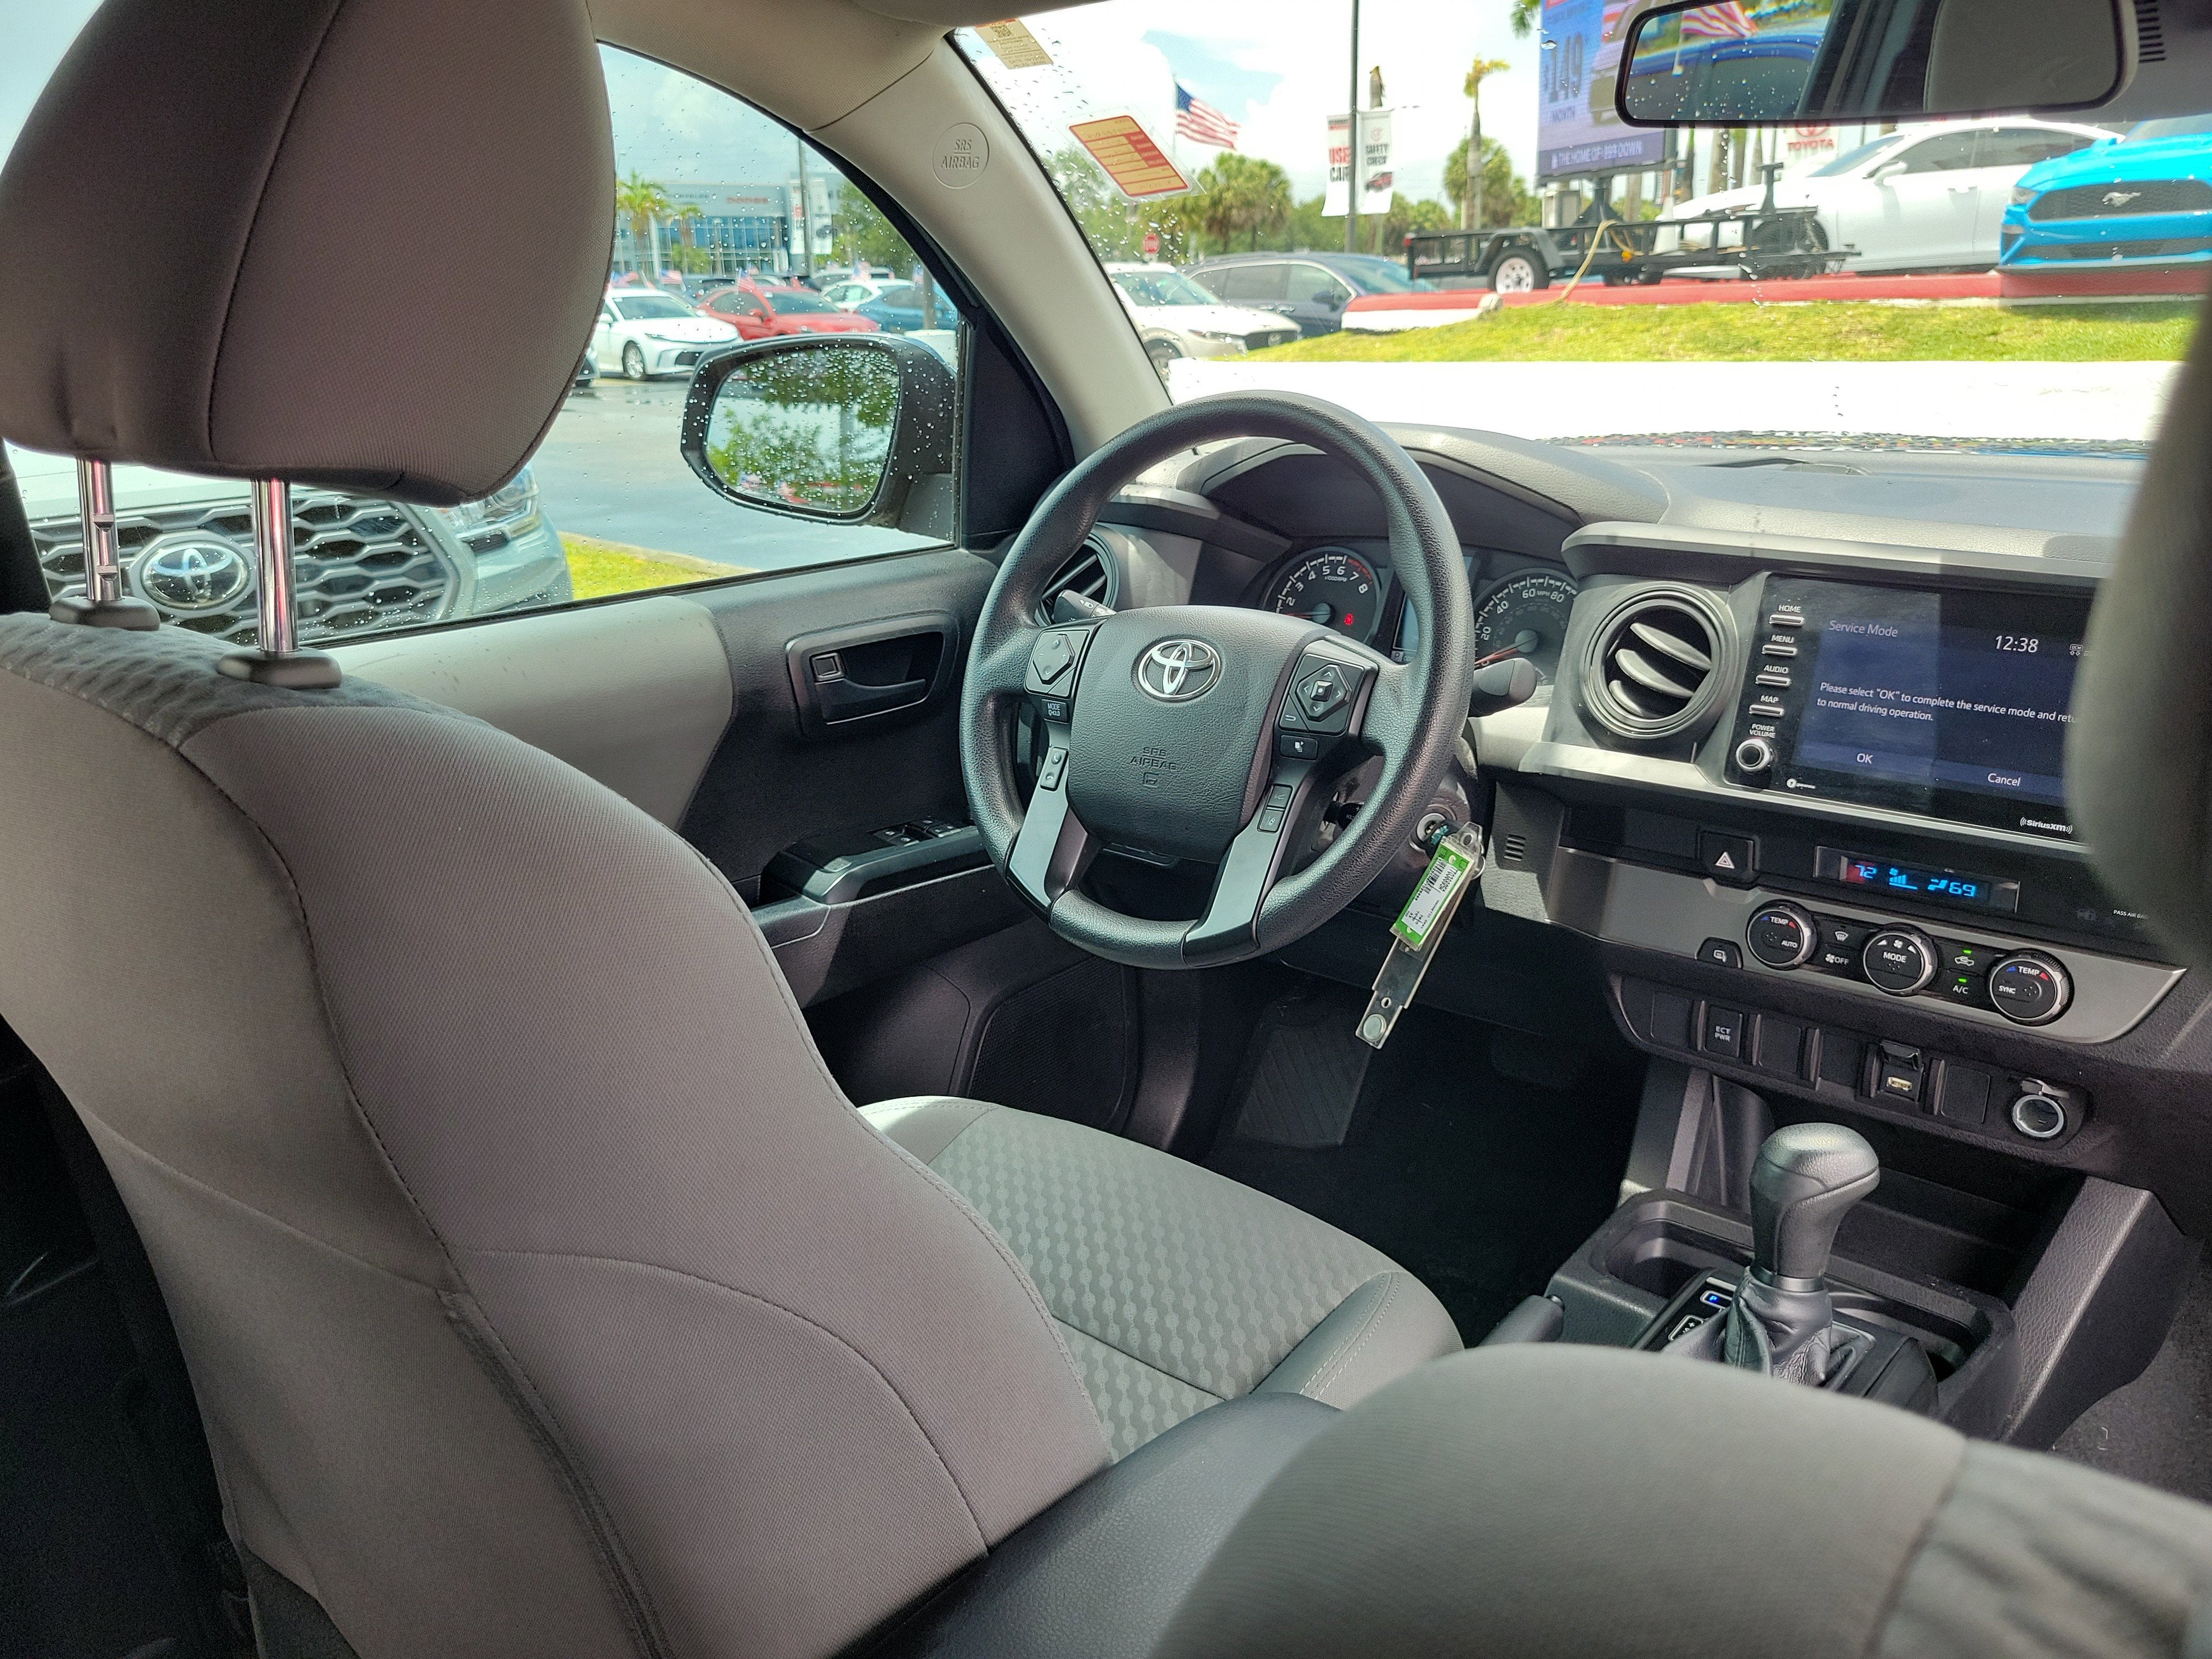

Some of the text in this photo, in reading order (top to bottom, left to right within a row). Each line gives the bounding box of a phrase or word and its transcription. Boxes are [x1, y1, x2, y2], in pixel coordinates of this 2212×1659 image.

[955, 139, 972, 151] SRS
[1787, 138, 1833, 151] TOYOTA
[1329, 146, 1351, 164] USE
[941, 156, 979, 169] AIRBAG
[1308, 571, 1317, 580] 4
[1322, 566, 1330, 575] 5
[1336, 566, 1346, 575] 6
[1350, 572, 1359, 581] 7
[1295, 582, 1304, 591] 3
[1358, 583, 1368, 594] 8
[1522, 588, 1536, 599] 60
[1550, 591, 1564, 603] 80
[1286, 597, 1295, 606] 2
[1497, 601, 1509, 614] 40
[1778, 605, 1802, 613] HOME
[1829, 620, 1898, 637] Service Mode
[1481, 627, 1491, 641] 20
[1771, 635, 1794, 644] MENU
[1995, 635, 2039, 653] 12:38
[1763, 665, 1789, 674] AUDIO
[1760, 695, 1779, 703] MAP
[1820, 682, 1847, 695] Please
[1849, 687, 1874, 697] select
[1876, 689, 1900, 700] "OK"
[1901, 693, 1911, 702] to
[1912, 695, 1954, 708] complete
[1956, 700, 1972, 710] the
[1973, 703, 2006, 714] service
[2008, 708, 2035, 718] mode
[2037, 712, 2056, 721] and
[1047, 702, 1060, 710] MODE
[1817, 698, 1933, 721] to normal driving operation.
[1751, 724, 1775, 732] POWER
[1749, 729, 1776, 738] VOLUME
[1857, 753, 1874, 764] OK
[1987, 773, 2021, 786] Cancel
[1854, 864, 1877, 879] 72
[1949, 882, 1977, 897] 69
[1770, 916, 1789, 926] TEMP
[1781, 940, 1798, 948] AUTO
[1883, 952, 1907, 963] MODE
[2018, 966, 2040, 976] TEMP
[1953, 985, 1968, 995] A/C
[1998, 985, 2016, 995] SYNC
[1716, 1026, 1731, 1034] ECT
[1715, 1032, 1731, 1042] PWR
